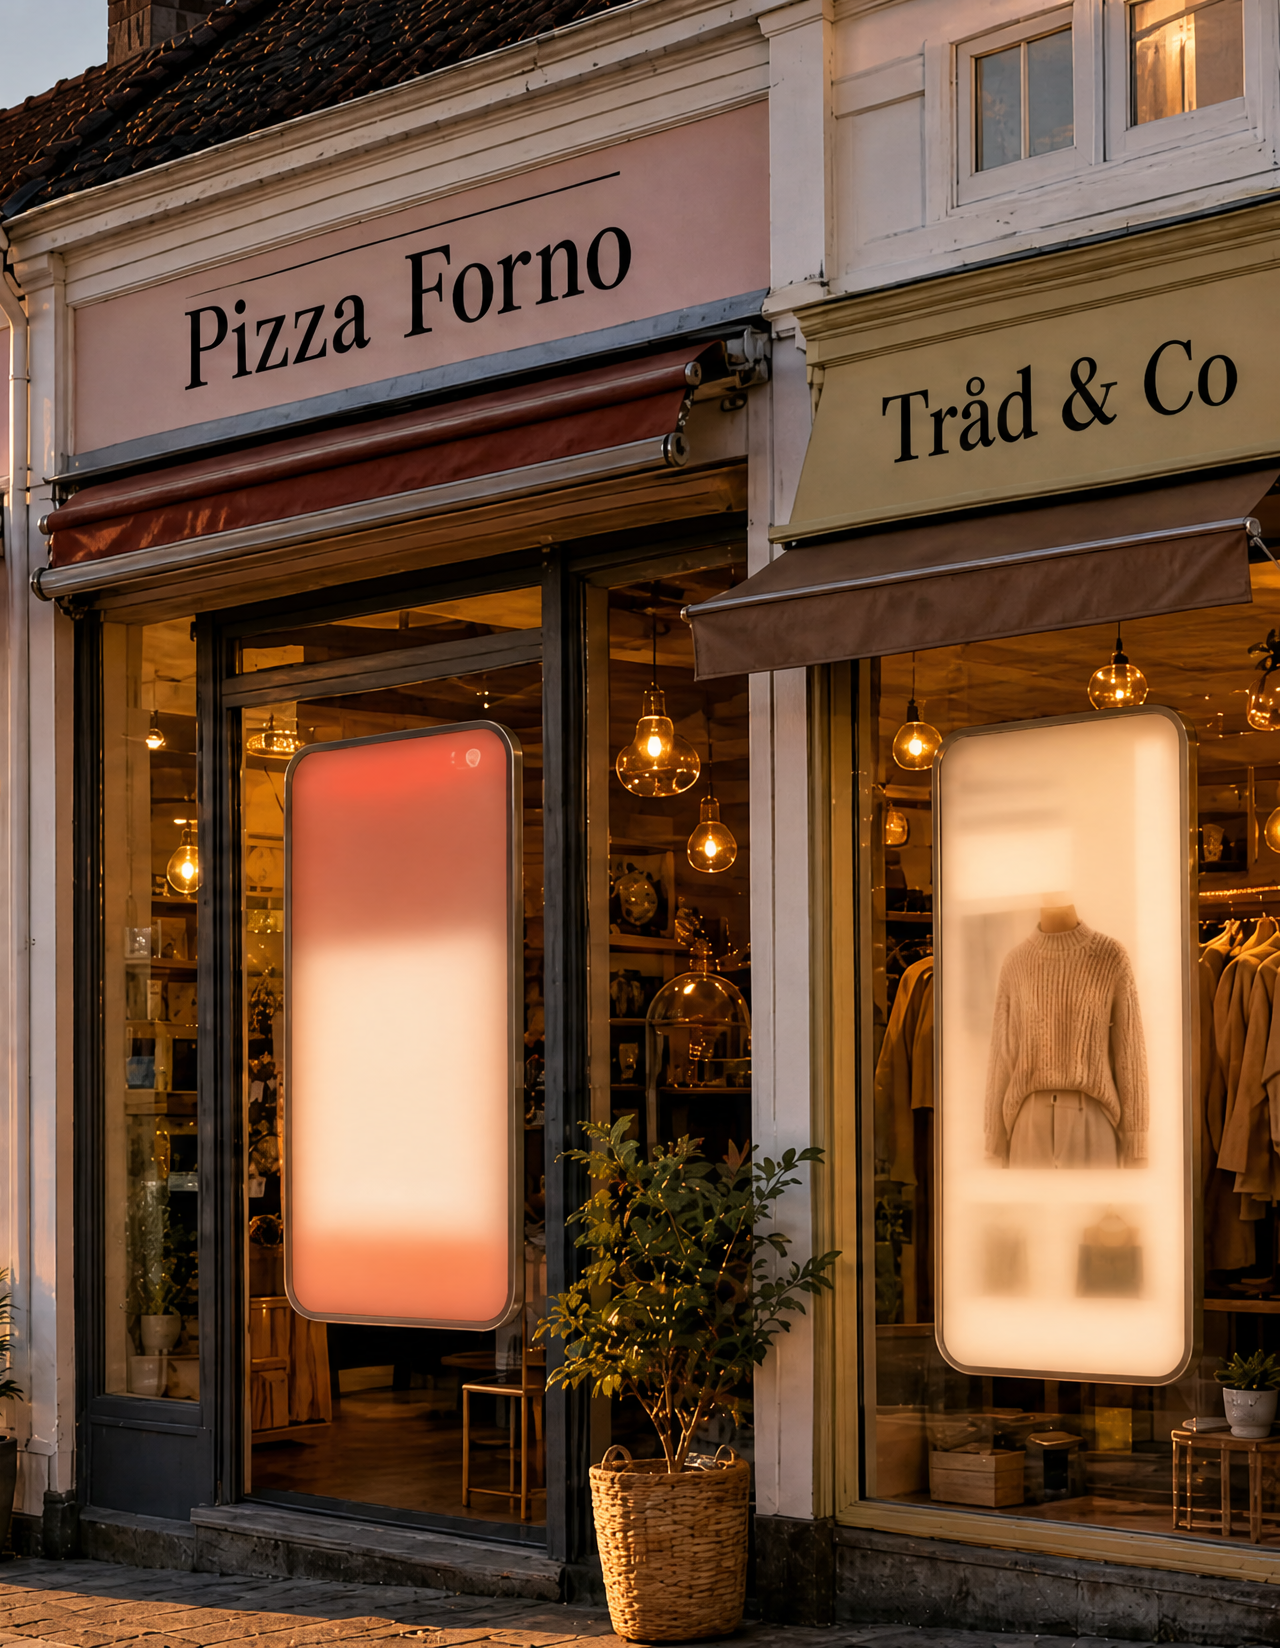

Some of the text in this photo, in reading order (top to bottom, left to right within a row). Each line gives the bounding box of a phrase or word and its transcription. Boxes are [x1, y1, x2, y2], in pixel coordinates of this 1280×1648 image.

[184, 226, 632, 391] Pizza Forno
[882, 339, 1238, 463] Tråd & Co
